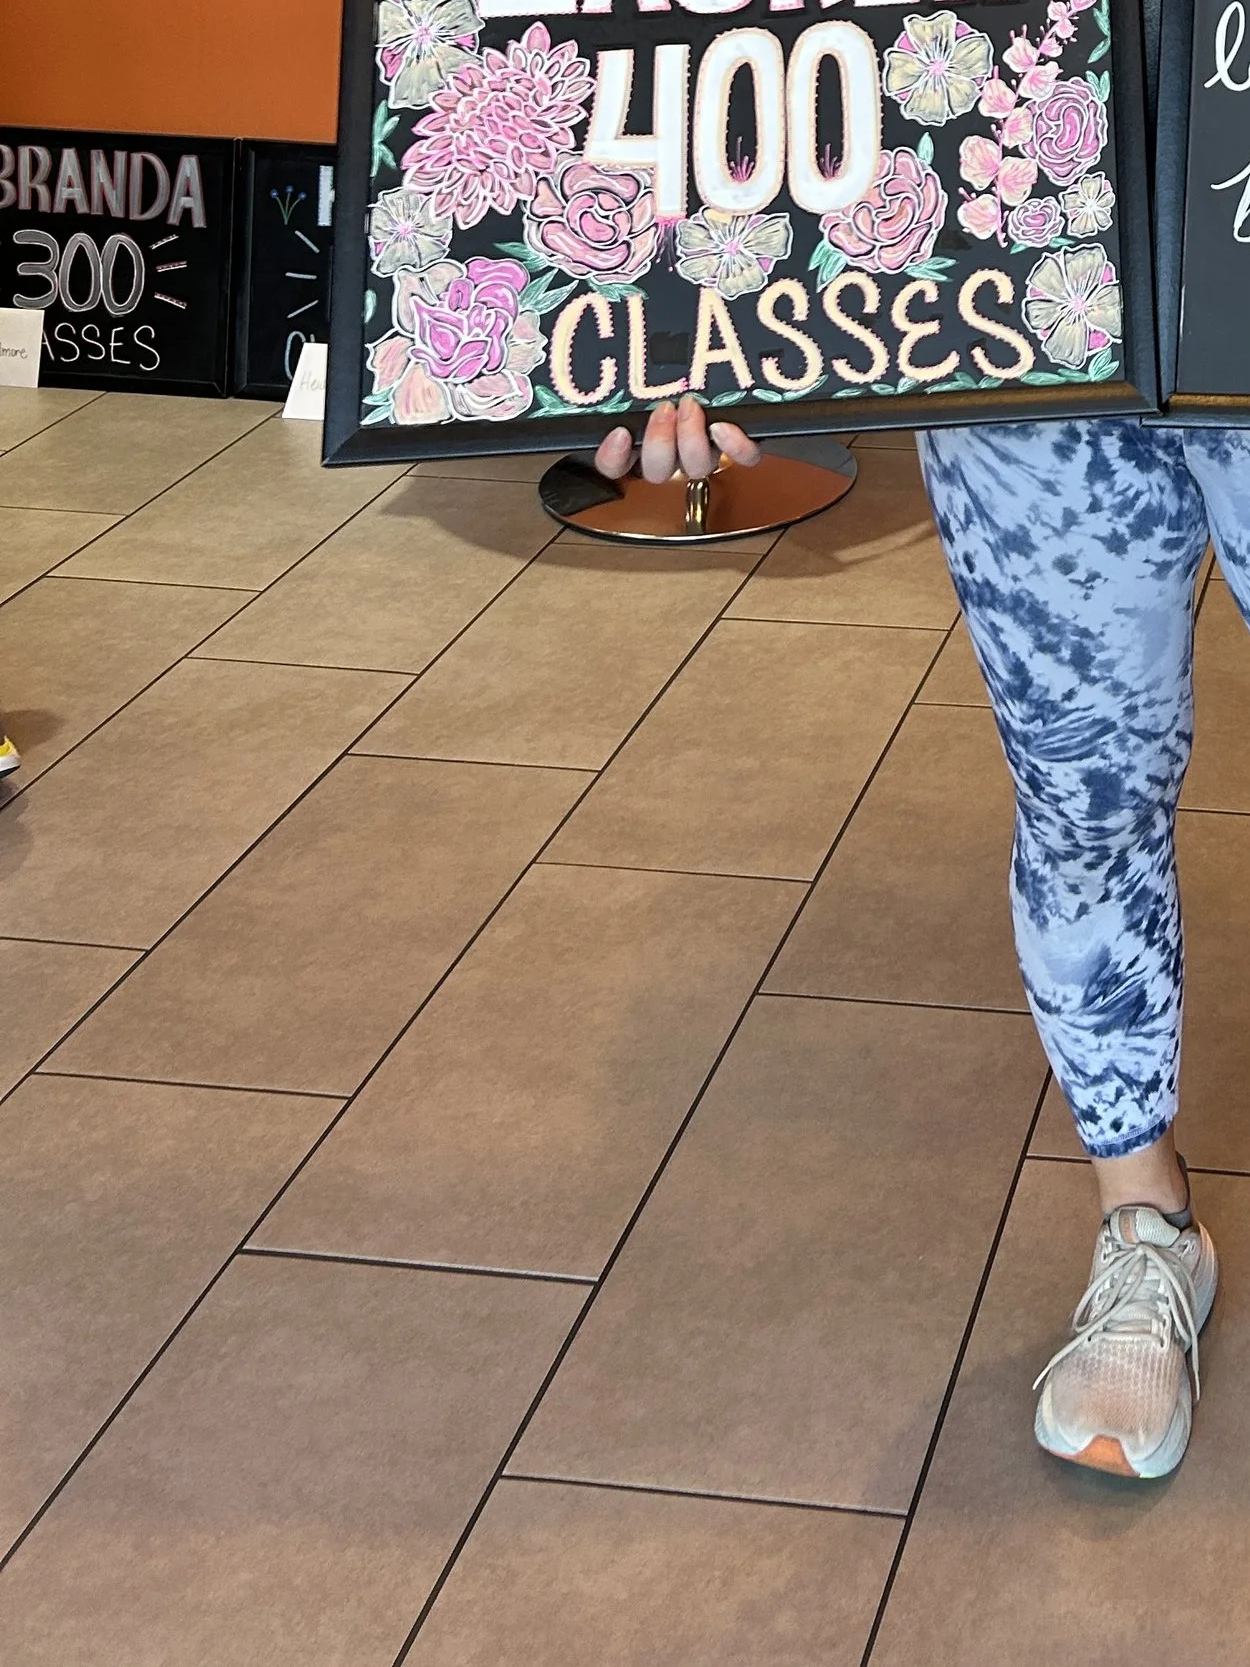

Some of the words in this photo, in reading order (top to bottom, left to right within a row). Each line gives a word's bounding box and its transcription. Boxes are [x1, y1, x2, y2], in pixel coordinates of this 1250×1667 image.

[584, 20, 884, 219] 400
[13, 229, 146, 316] 300
[549, 268, 1036, 406] CLASSES
